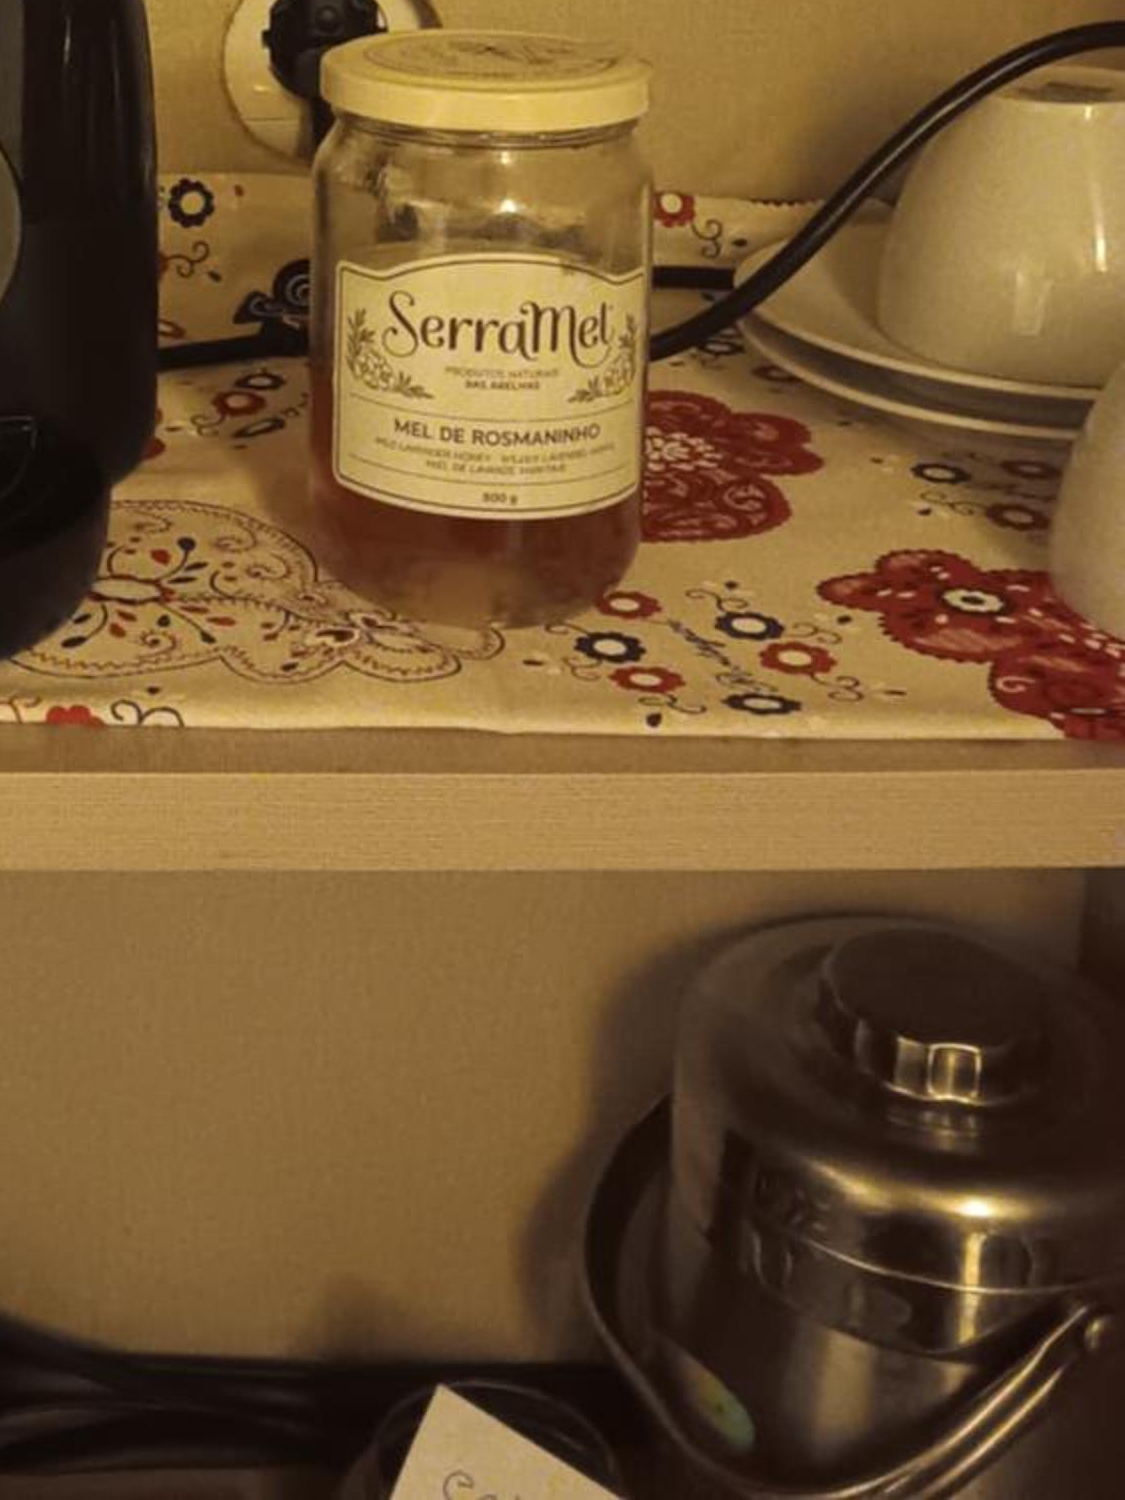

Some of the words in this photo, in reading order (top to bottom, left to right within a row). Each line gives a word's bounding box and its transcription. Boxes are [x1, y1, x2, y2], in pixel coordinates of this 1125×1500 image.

[394, 417, 432, 440] MEL
[439, 424, 465, 444] DE
[471, 422, 601, 448] ROSMANINHO
